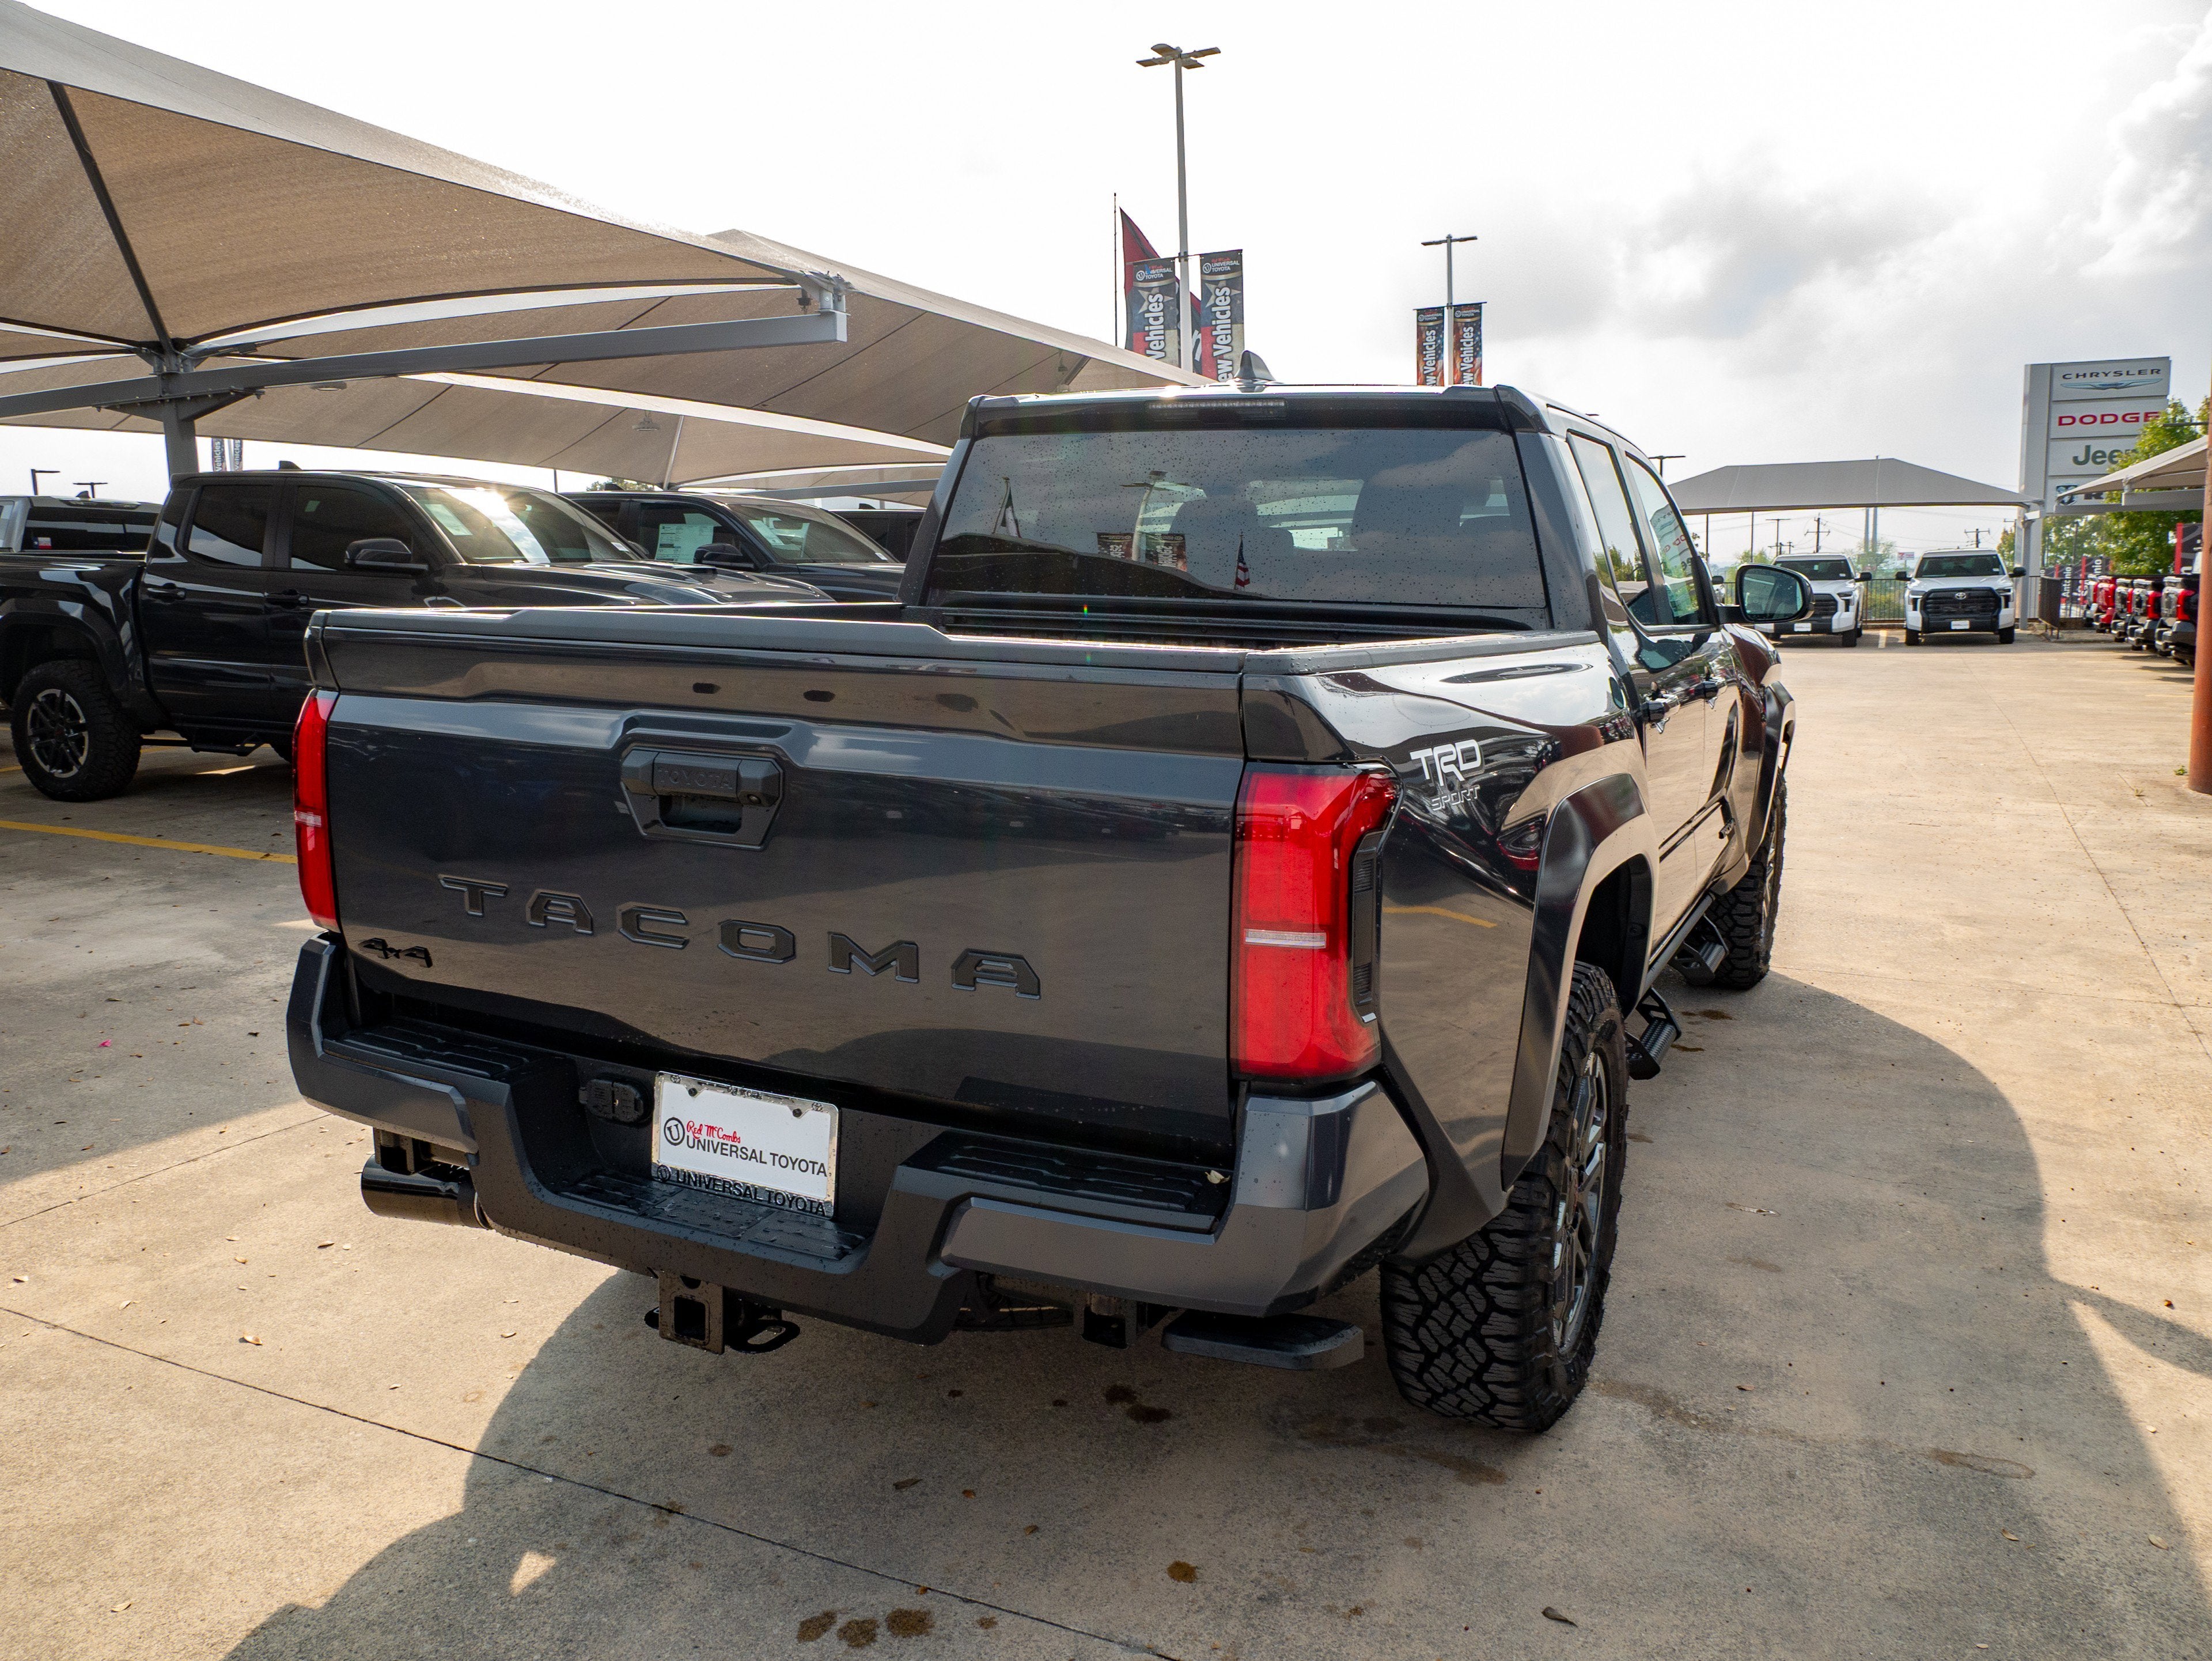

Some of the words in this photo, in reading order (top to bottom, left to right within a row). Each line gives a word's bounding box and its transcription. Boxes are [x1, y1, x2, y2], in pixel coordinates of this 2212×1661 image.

[1211, 287, 1233, 357] Vehicles
[1423, 330, 1436, 374] Vehicles
[1460, 326, 1474, 371] Vehicles
[1217, 359, 1233, 382] ew
[2062, 368, 2161, 380] CHRYSLER
[2072, 445, 2139, 466] Jee
[1410, 739, 1483, 786] TRD
[1431, 785, 1480, 811] SPORT
[438, 874, 1041, 1000] TACOMA
[686, 1120, 703, 1140] Red
[704, 1124, 741, 1144] McCombs
[687, 1135, 767, 1164] UNIVERSAL
[770, 1152, 828, 1177] TOYOTA
[676, 1168, 764, 1201] UNIVERSAL
[765, 1187, 827, 1217] TOYOTA
